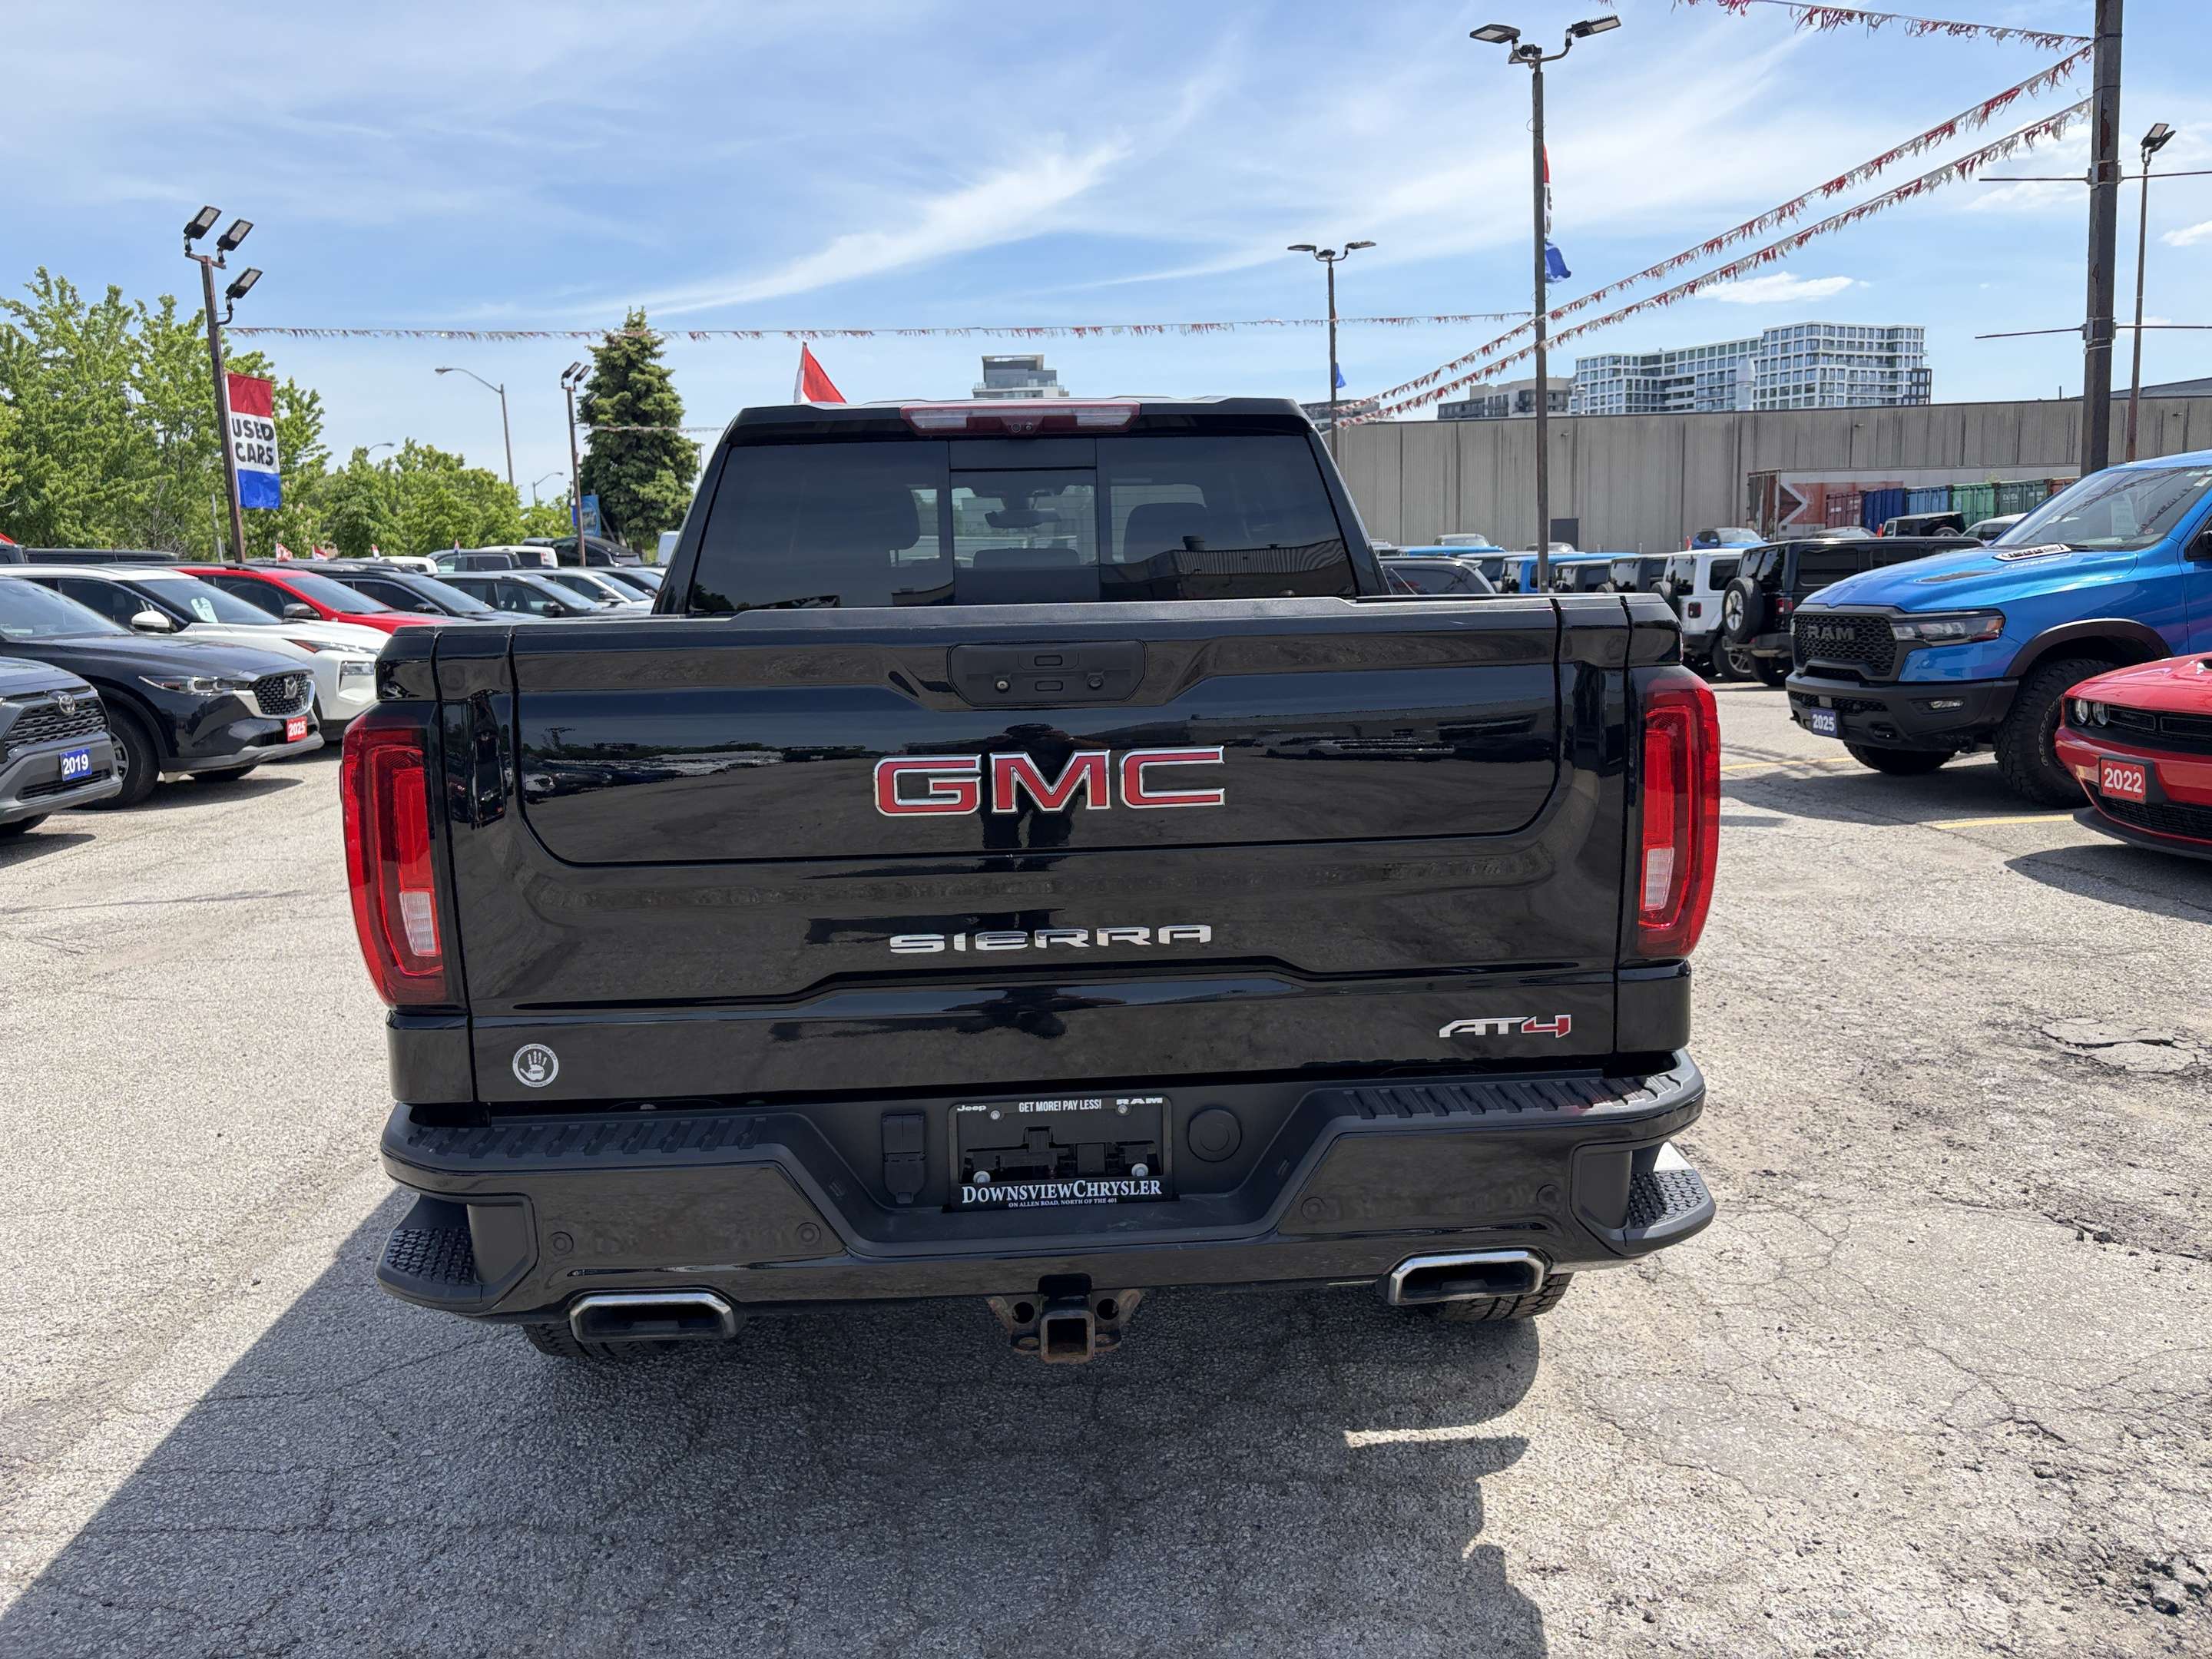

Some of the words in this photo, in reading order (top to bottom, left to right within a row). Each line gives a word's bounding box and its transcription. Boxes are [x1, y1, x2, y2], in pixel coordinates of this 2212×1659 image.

[232, 417, 274, 442] USED
[235, 442, 274, 466] CARS
[1807, 625, 1856, 640] RAM
[288, 720, 306, 737] 2025
[1812, 714, 1835, 732] 2025
[62, 753, 89, 775] 2019
[874, 745, 1225, 816] GMC
[2104, 767, 2143, 793] 2022
[889, 924, 1212, 954] SIERRA
[1439, 1014, 1571, 1038] AT4
[1018, 1101, 1035, 1113] GET
[1035, 1100, 1061, 1112] MORE!
[1062, 1099, 1078, 1111] PAY
[1079, 1098, 1102, 1110] LESS!
[1116, 1097, 1163, 1105] RAM
